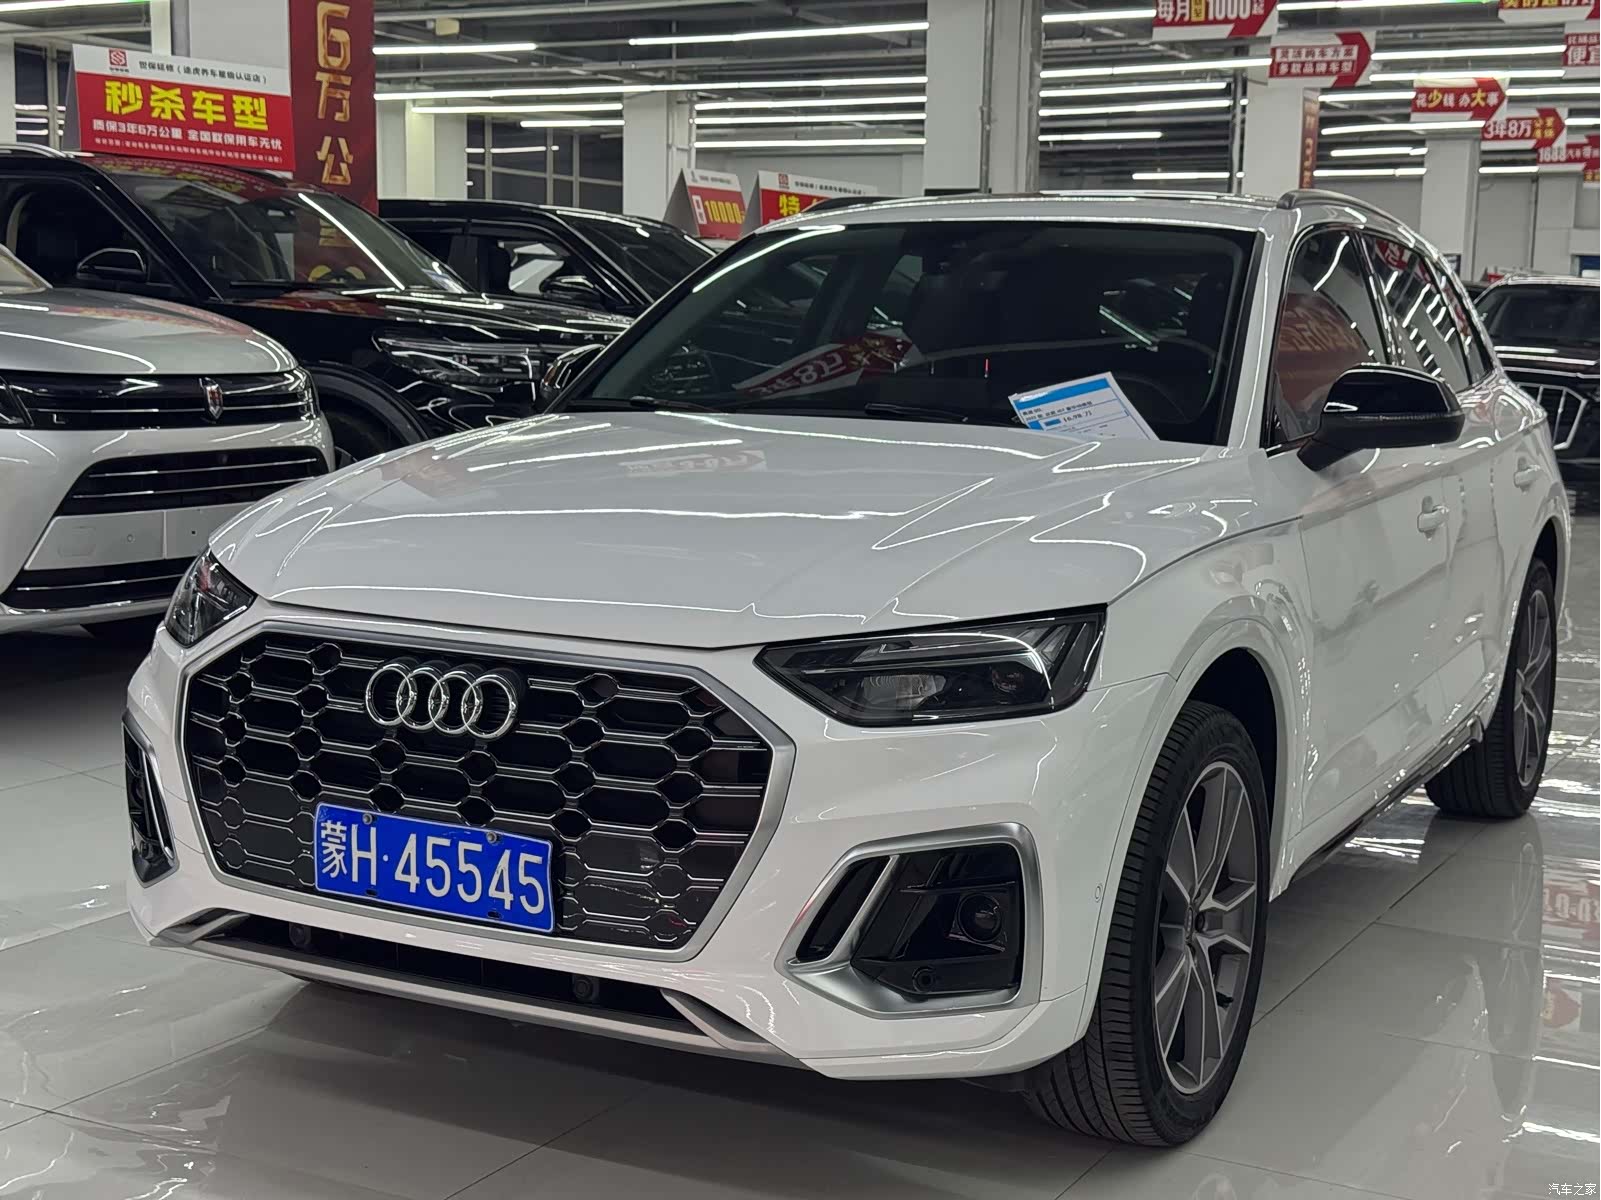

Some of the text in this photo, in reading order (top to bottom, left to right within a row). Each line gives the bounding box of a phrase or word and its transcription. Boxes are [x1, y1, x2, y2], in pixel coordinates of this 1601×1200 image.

[105, 80, 268, 131] 秒杀车型
[93, 119, 182, 140] 质保3年6万公里
[704, 200, 745, 224] 10000
[319, 819, 545, 915] 蒙H·45545
